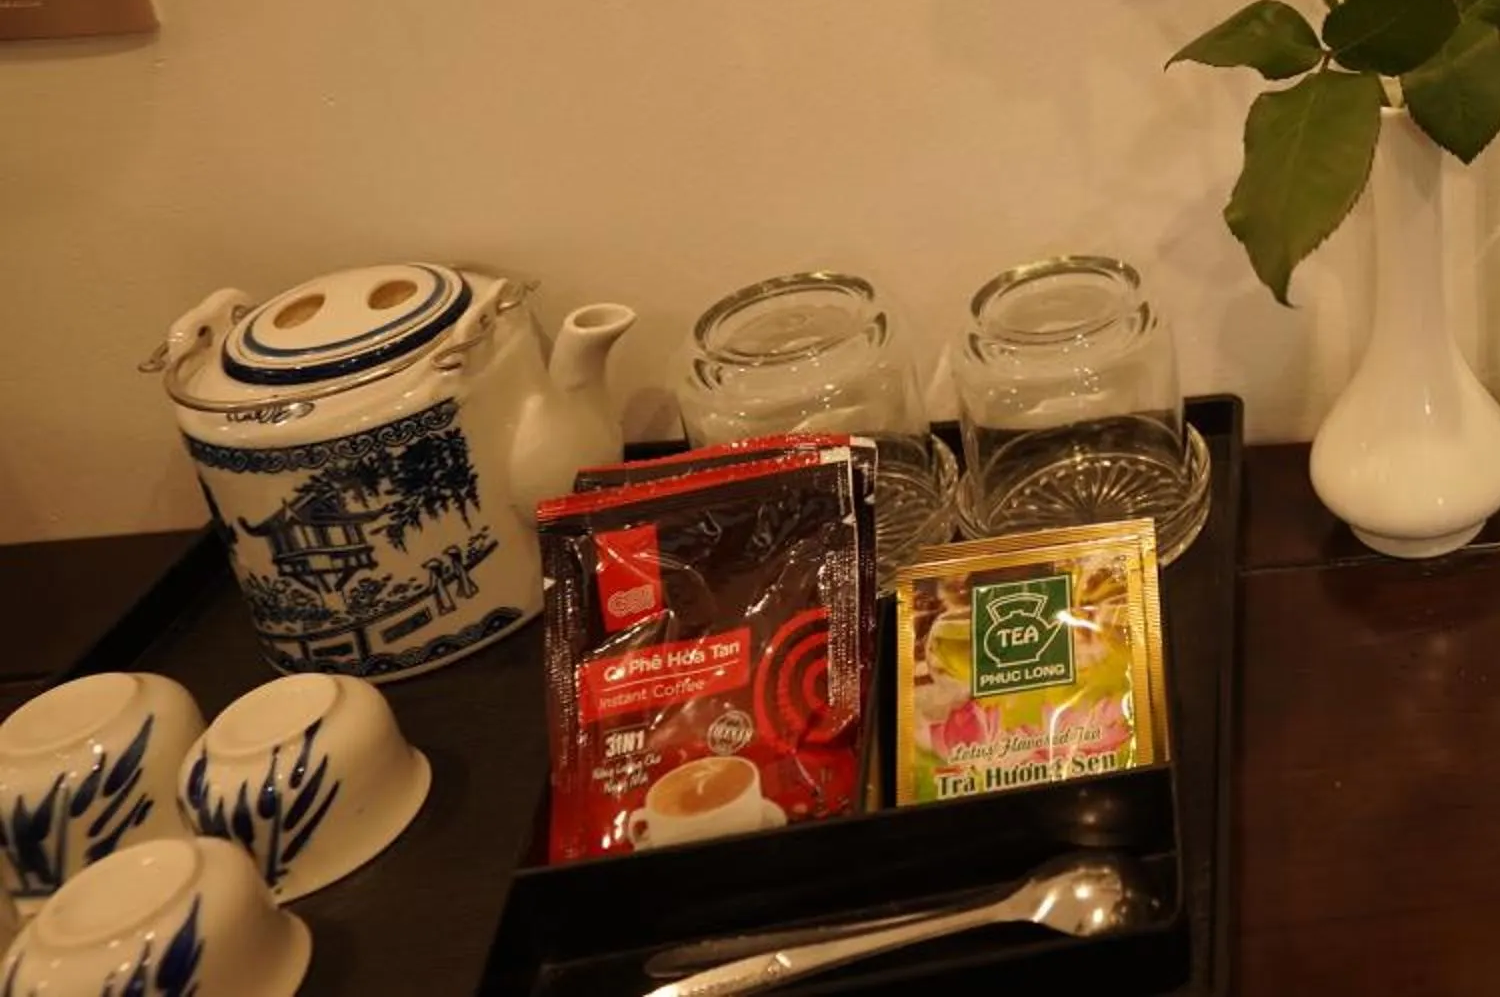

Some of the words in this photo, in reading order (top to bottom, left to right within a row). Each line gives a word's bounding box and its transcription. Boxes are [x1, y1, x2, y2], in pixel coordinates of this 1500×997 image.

[997, 625, 1039, 648] TEA
[628, 654, 662, 674] Phê
[708, 640, 740, 660] Tan
[1025, 664, 1065, 680] LONG
[599, 688, 648, 709] Instant
[652, 678, 705, 698] Coffee
[938, 765, 976, 796] Trà
[1071, 753, 1116, 774] Sen
